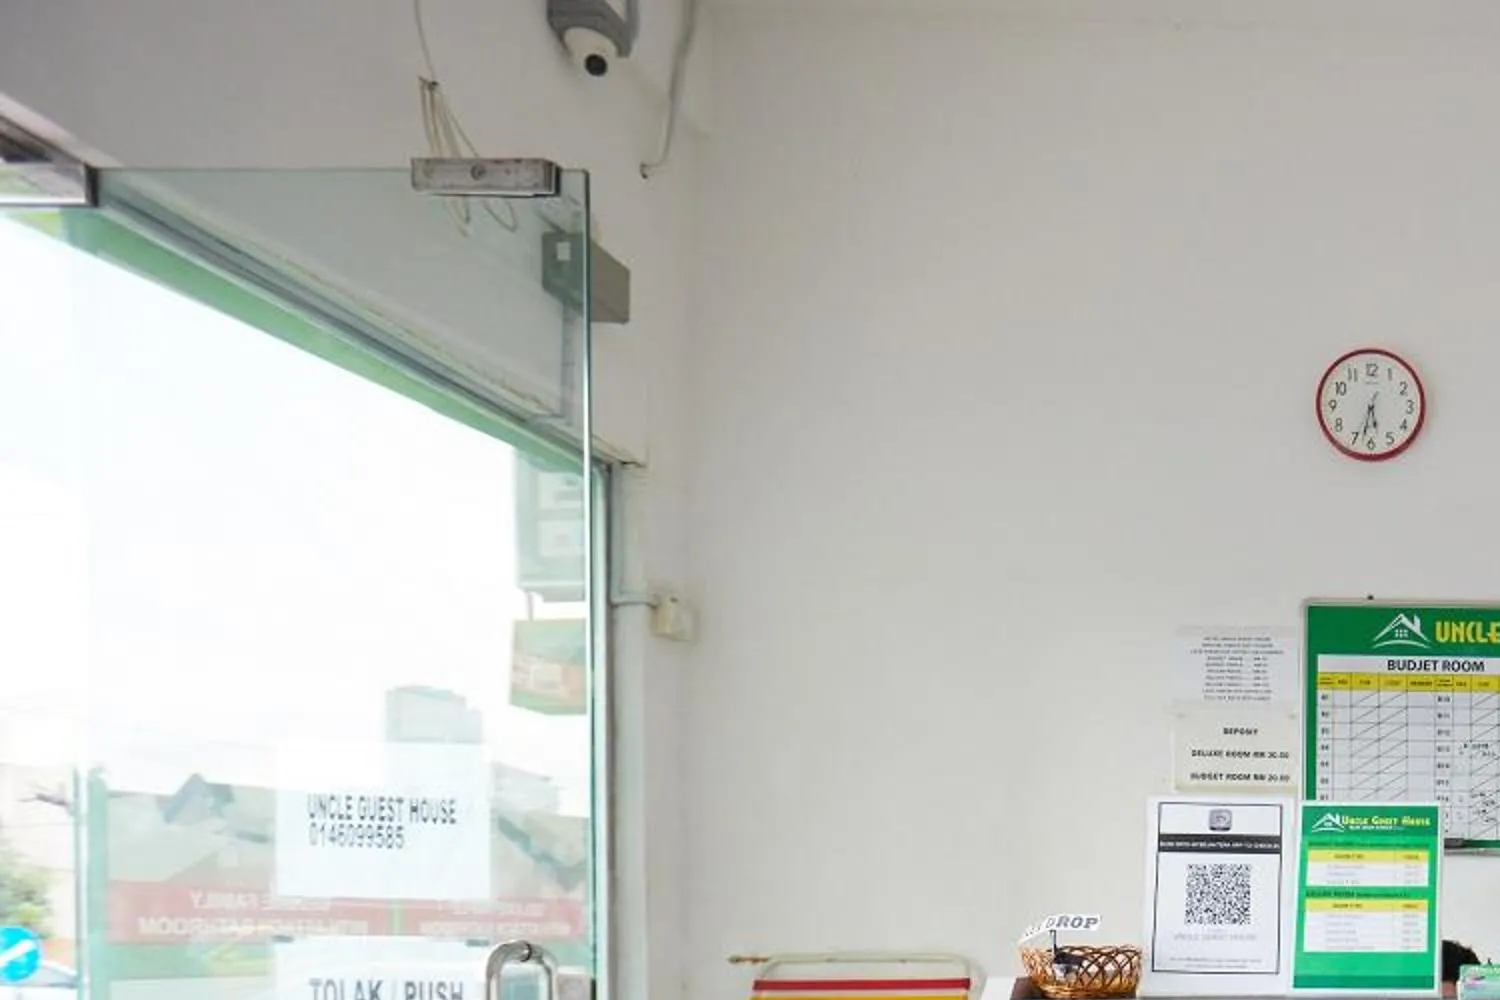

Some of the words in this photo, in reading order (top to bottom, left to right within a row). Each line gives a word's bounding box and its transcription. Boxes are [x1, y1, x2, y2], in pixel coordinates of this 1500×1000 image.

[1347, 367, 1358, 382] 11
[1365, 363, 1379, 377] 12
[1387, 367, 1393, 381] 1
[1335, 381, 1347, 396] 10
[1399, 381, 1408, 396] 2
[1328, 399, 1337, 412] 9
[1406, 399, 1415, 415] 3
[1334, 418, 1343, 432] 8
[1399, 418, 1408, 431] 4
[1351, 431, 1359, 445] 7
[1366, 437, 1376, 450] 6
[1385, 432, 1395, 445] 5
[1387, 659, 1437, 671] BUDJET
[1442, 660, 1485, 672] ROOM
[1191, 749, 1223, 757] DELUXE
[1226, 750, 1251, 758] ROOM
[1226, 773, 1251, 781] ROOM
[307, 794, 353, 820] UNCLE
[358, 795, 403, 822] GUEST
[409, 798, 457, 824] HOUSE
